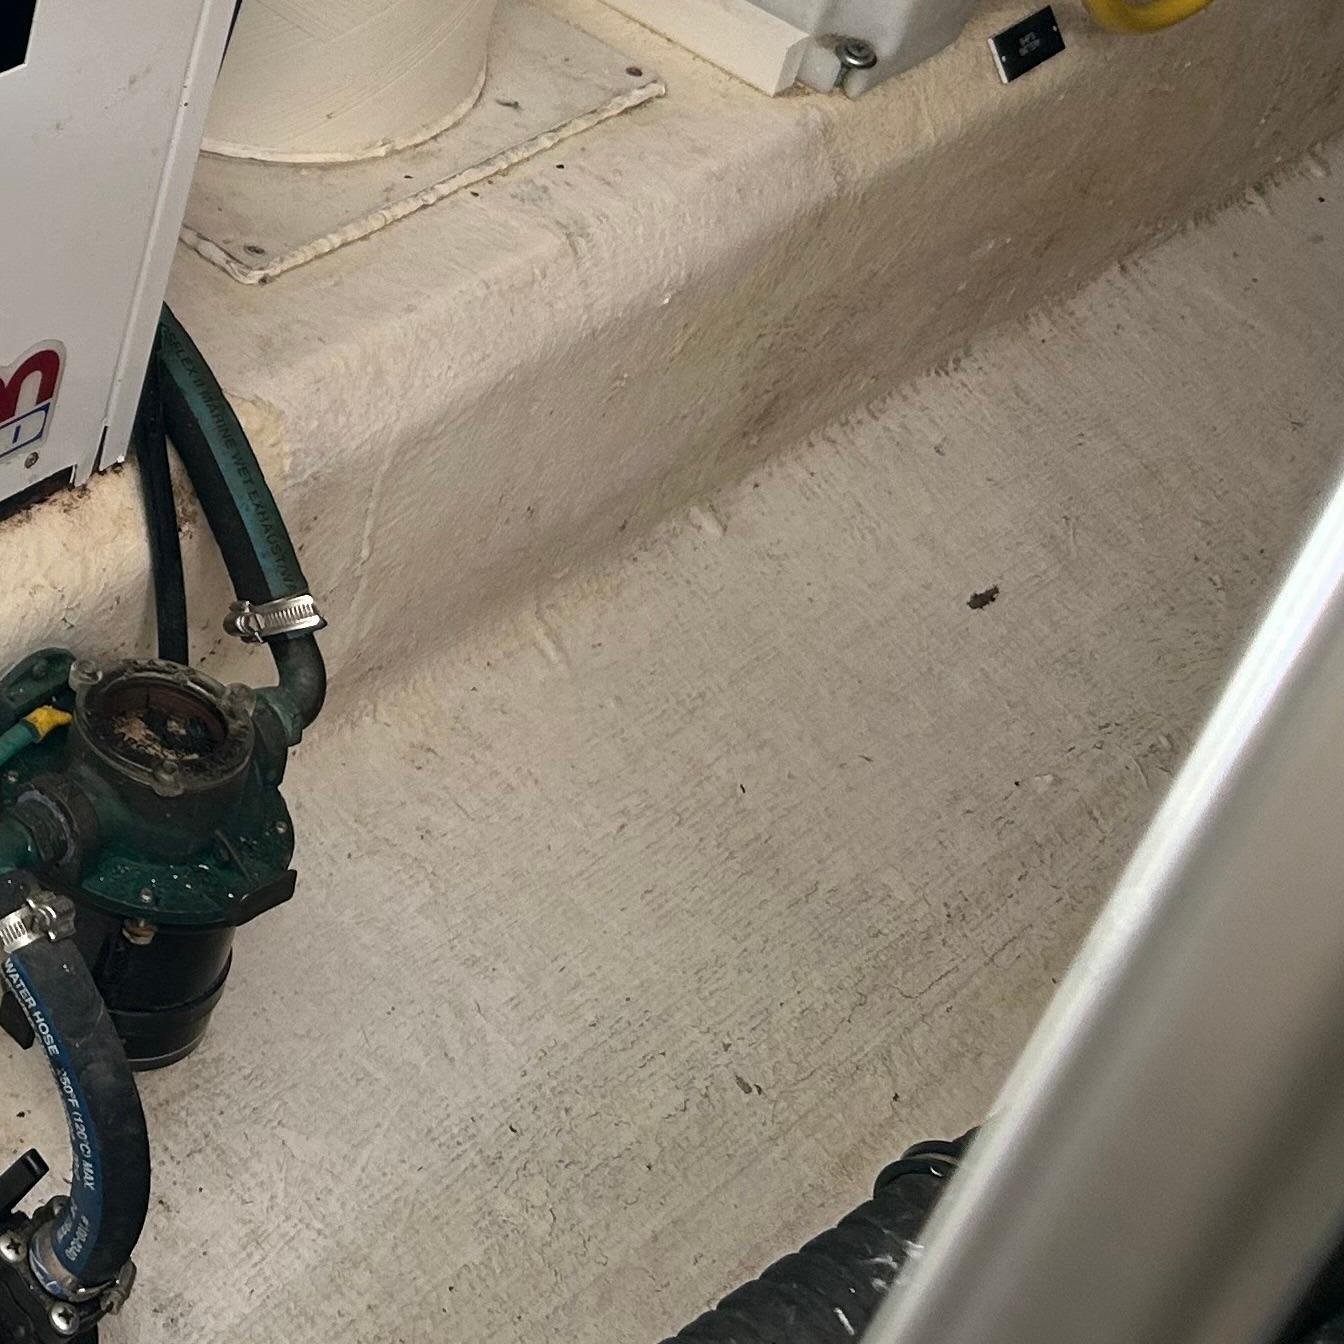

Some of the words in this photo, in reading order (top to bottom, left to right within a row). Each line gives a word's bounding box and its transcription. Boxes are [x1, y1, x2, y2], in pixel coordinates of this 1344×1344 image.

[199, 387, 239, 453] MARINE
[229, 453, 254, 486] WET
[4, 957, 37, 1009] WATER
[30, 1010, 60, 1057] HOSE
[83, 1158, 96, 1192] MAX
